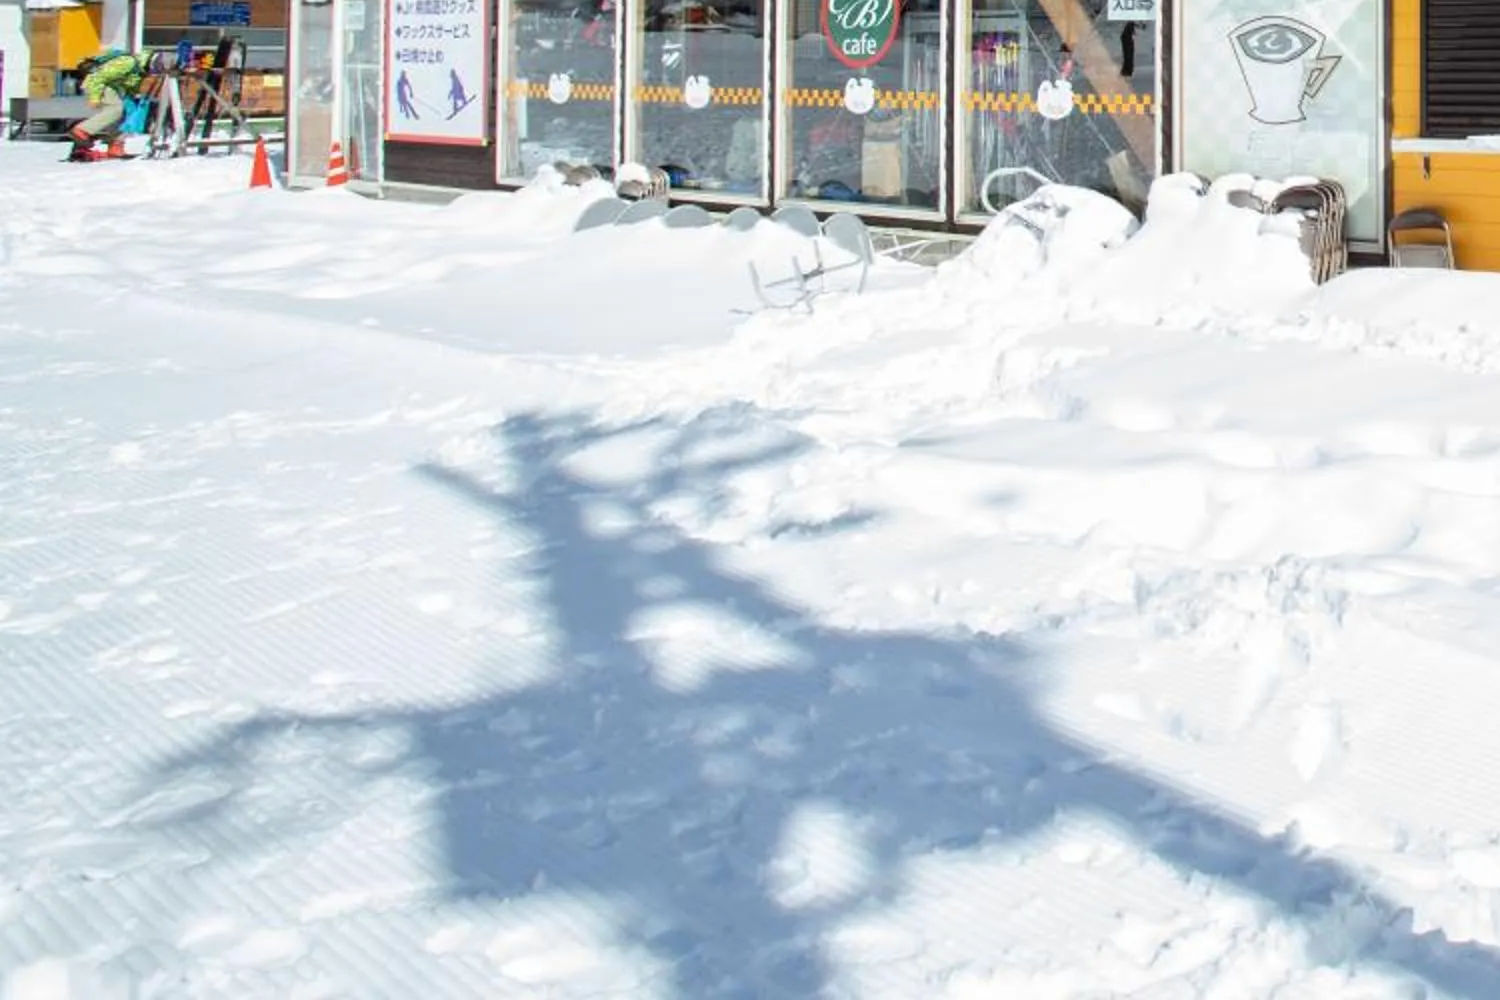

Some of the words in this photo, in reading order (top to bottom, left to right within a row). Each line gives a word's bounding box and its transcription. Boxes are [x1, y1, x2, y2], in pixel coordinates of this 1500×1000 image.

[402, 23, 471, 39] ワックスサービス
[842, 32, 877, 55] cafe
